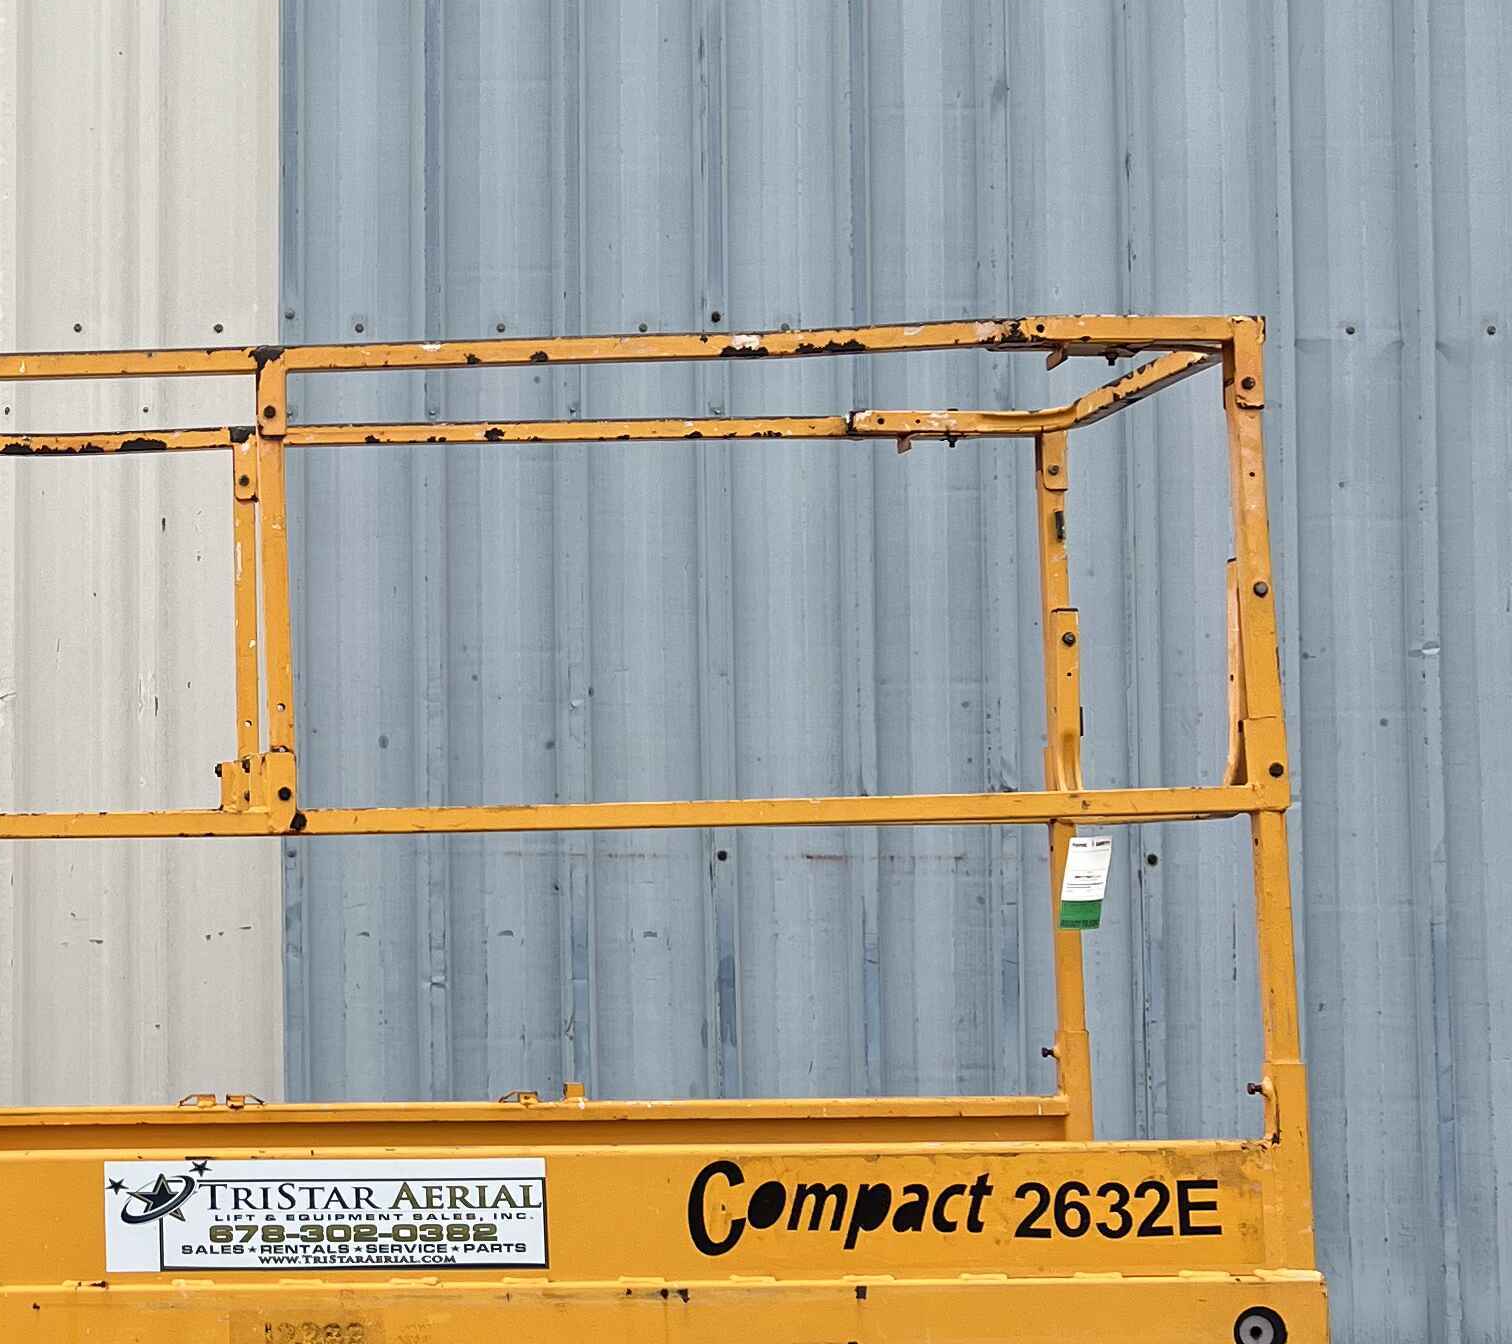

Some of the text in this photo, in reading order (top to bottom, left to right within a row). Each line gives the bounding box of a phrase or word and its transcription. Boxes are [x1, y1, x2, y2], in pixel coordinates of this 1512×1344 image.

[198, 1181, 542, 1210] TRISTAR AERIAL
[214, 1212, 535, 1222] LIFT & EQUIPMENT SALES, INC.
[687, 1159, 1223, 1257] Compact 2632E
[208, 1223, 499, 1244] 678-302-0382
[180, 1242, 528, 1256] SALES RENTALS SERVICE PARTS
